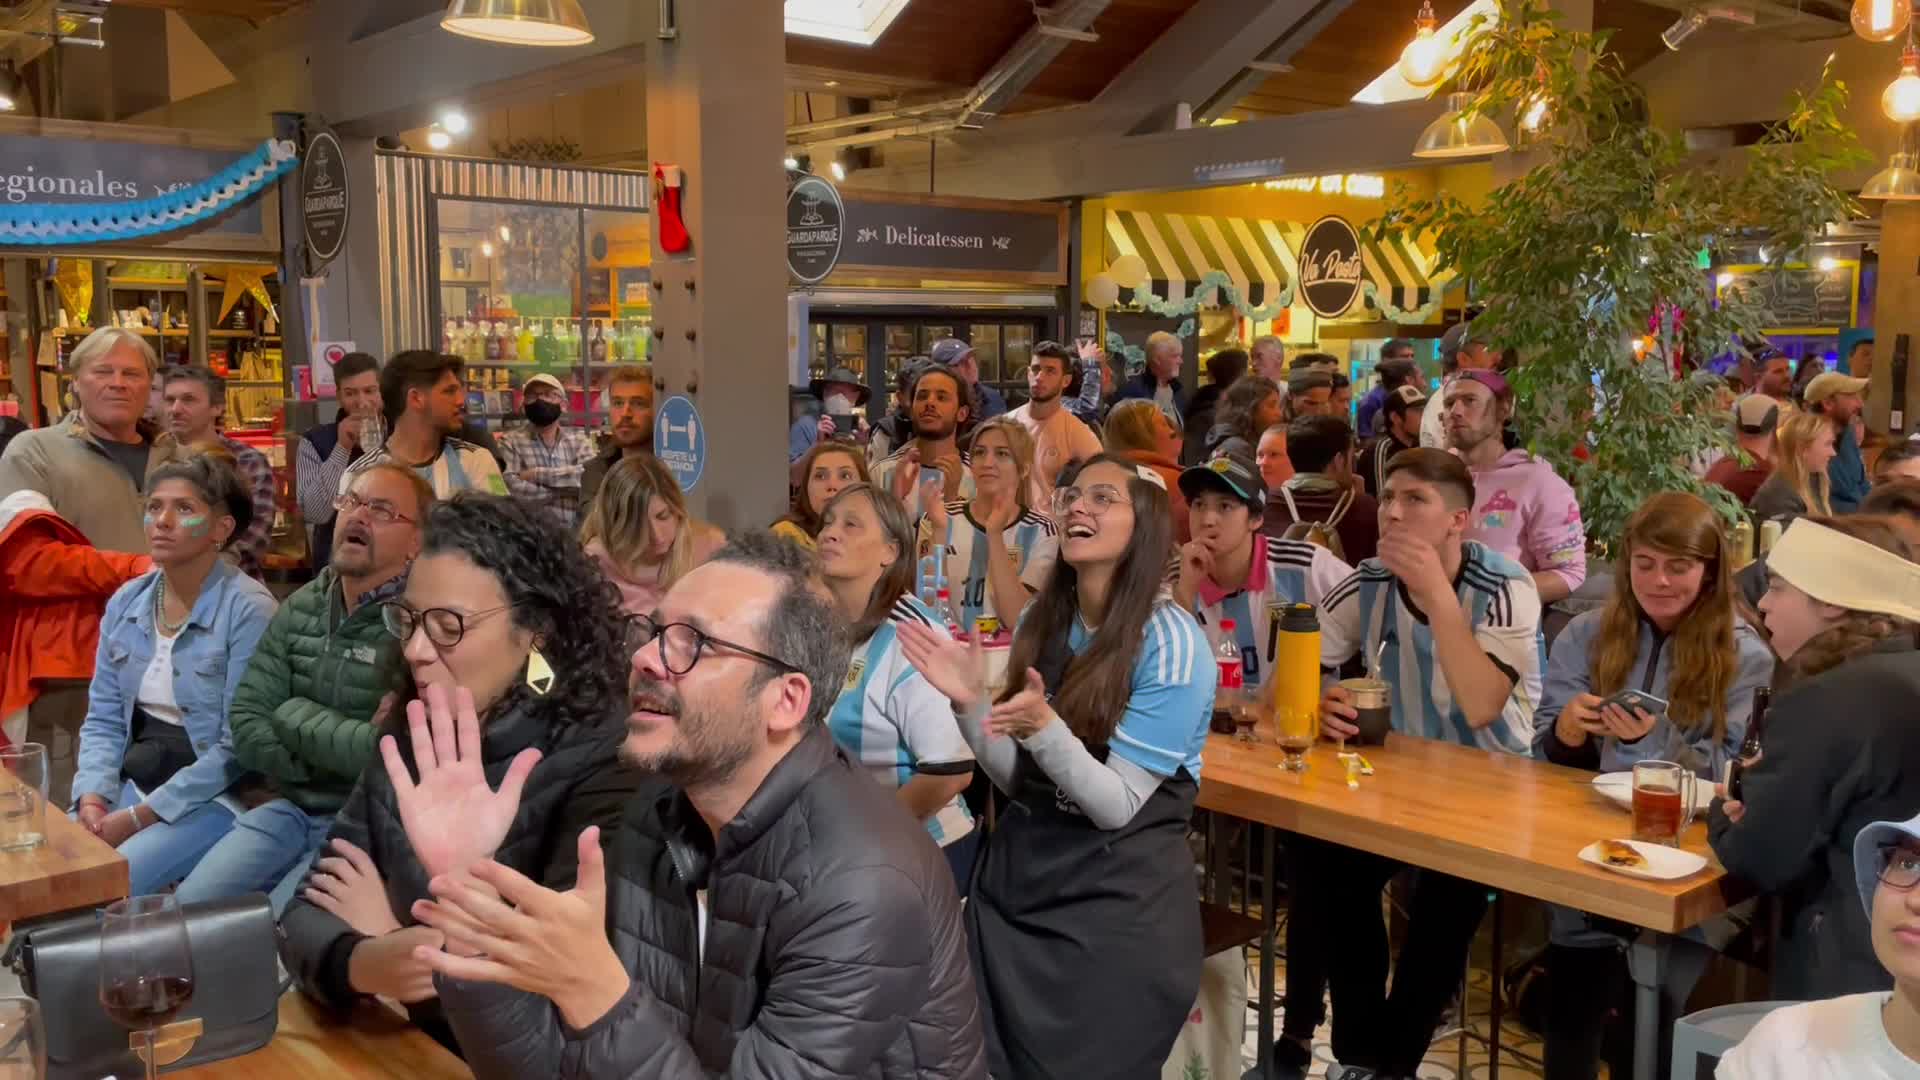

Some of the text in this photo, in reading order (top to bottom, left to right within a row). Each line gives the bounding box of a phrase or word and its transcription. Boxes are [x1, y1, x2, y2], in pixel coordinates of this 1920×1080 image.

[886, 225, 983, 248] Delicatessen
[1322, 249, 1362, 281] Pasta
[960, 577, 985, 607] 10
